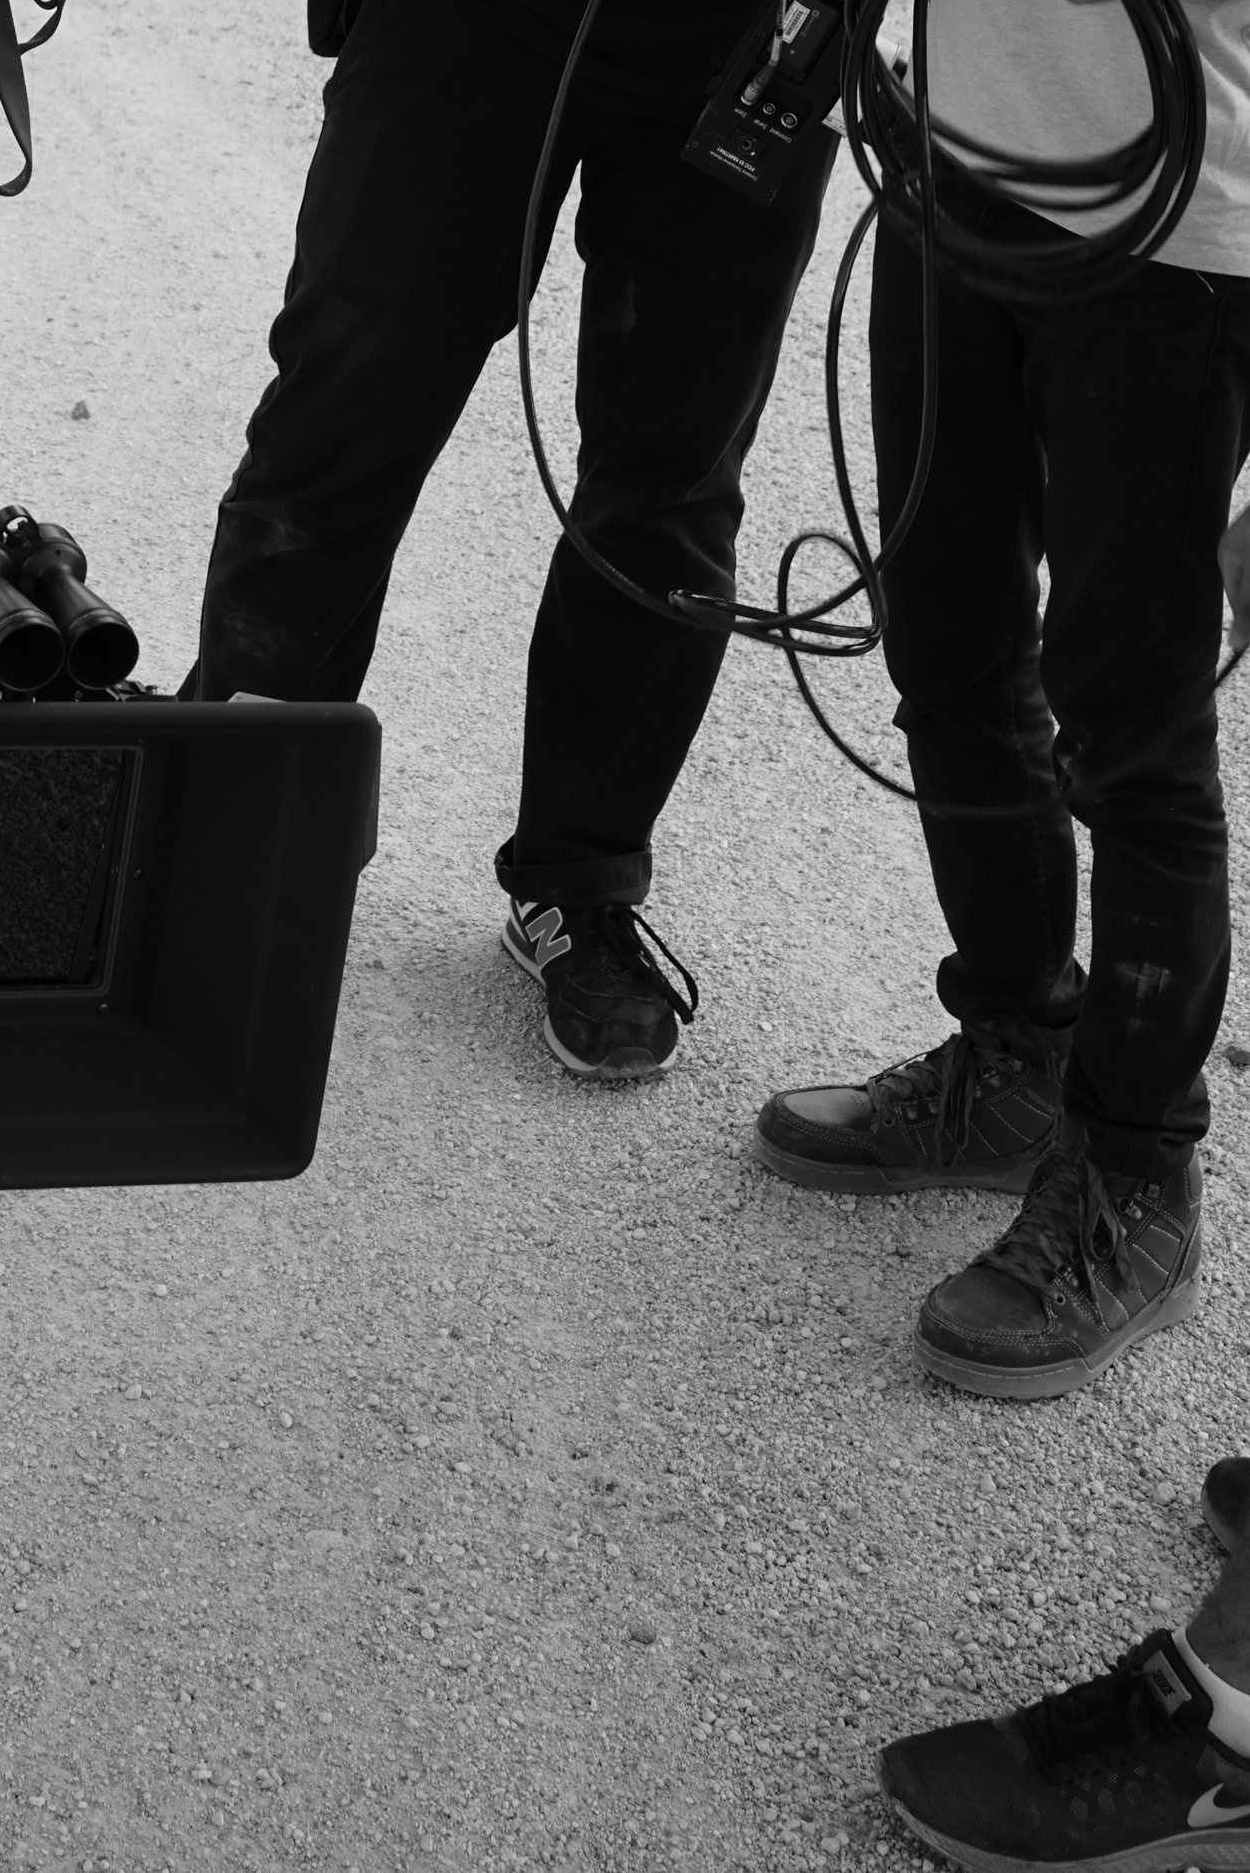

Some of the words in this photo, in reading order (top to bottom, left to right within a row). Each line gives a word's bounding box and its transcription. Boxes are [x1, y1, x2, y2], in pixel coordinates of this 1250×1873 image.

[734, 108, 748, 118] Zoom
[744, 162, 756, 172] FCC
[525, 906, 572, 969] N
